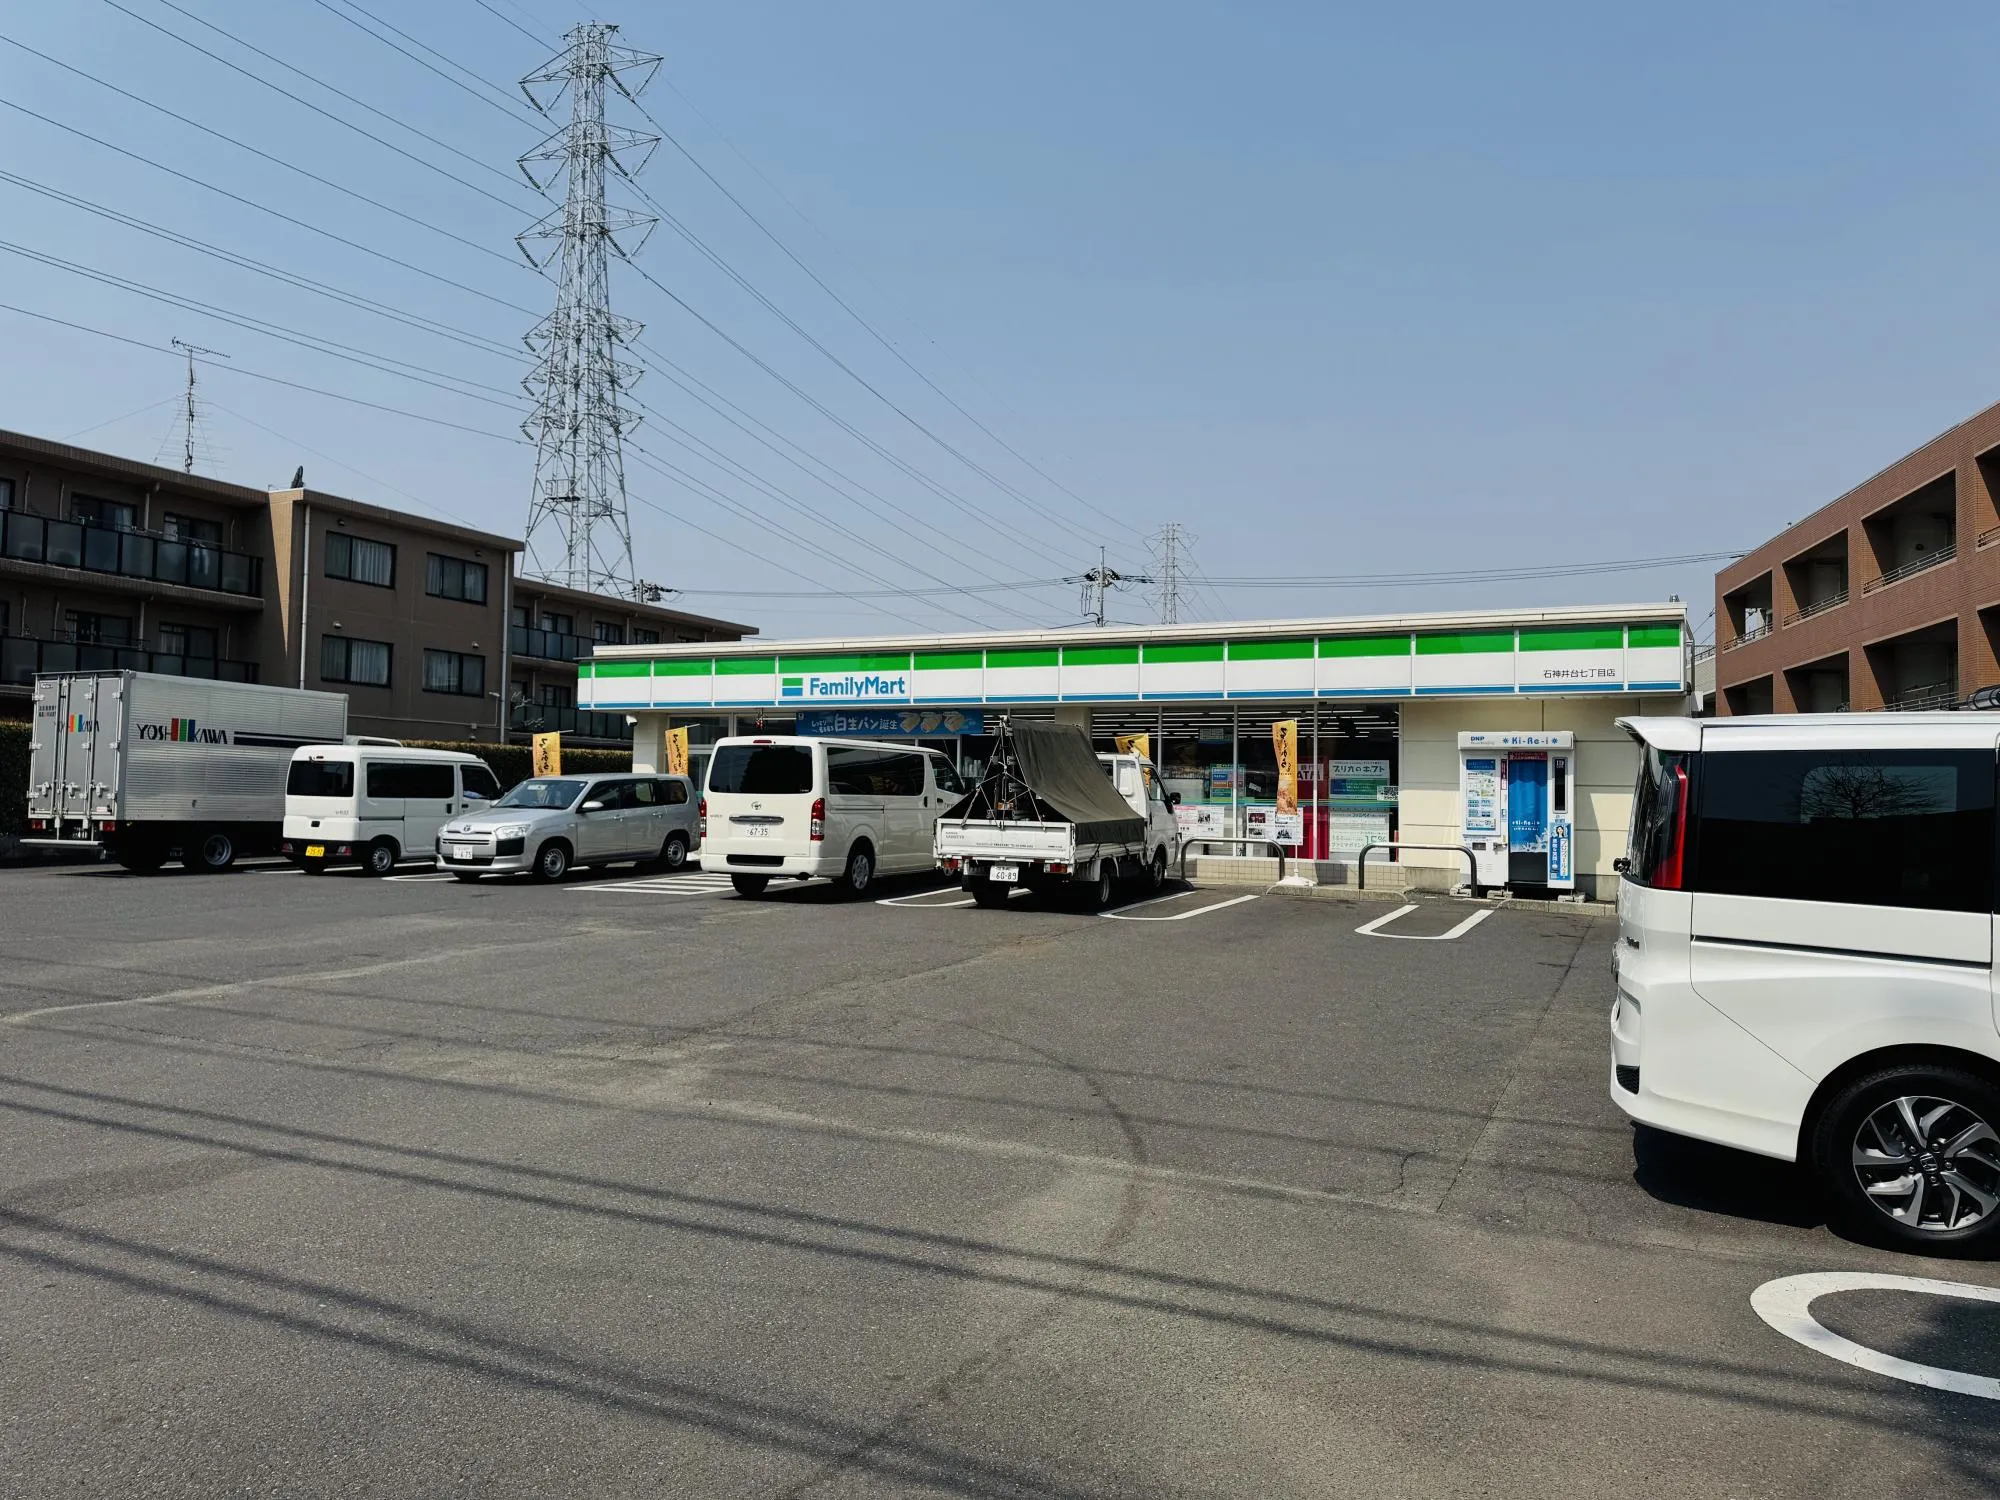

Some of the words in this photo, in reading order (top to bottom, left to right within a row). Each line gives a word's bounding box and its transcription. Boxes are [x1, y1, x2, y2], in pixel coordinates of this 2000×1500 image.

[1543, 668, 1616, 679] 石神井台七丁目店
[810, 676, 905, 697] FamilyMart
[995, 871, 1017, 880] 60-89
